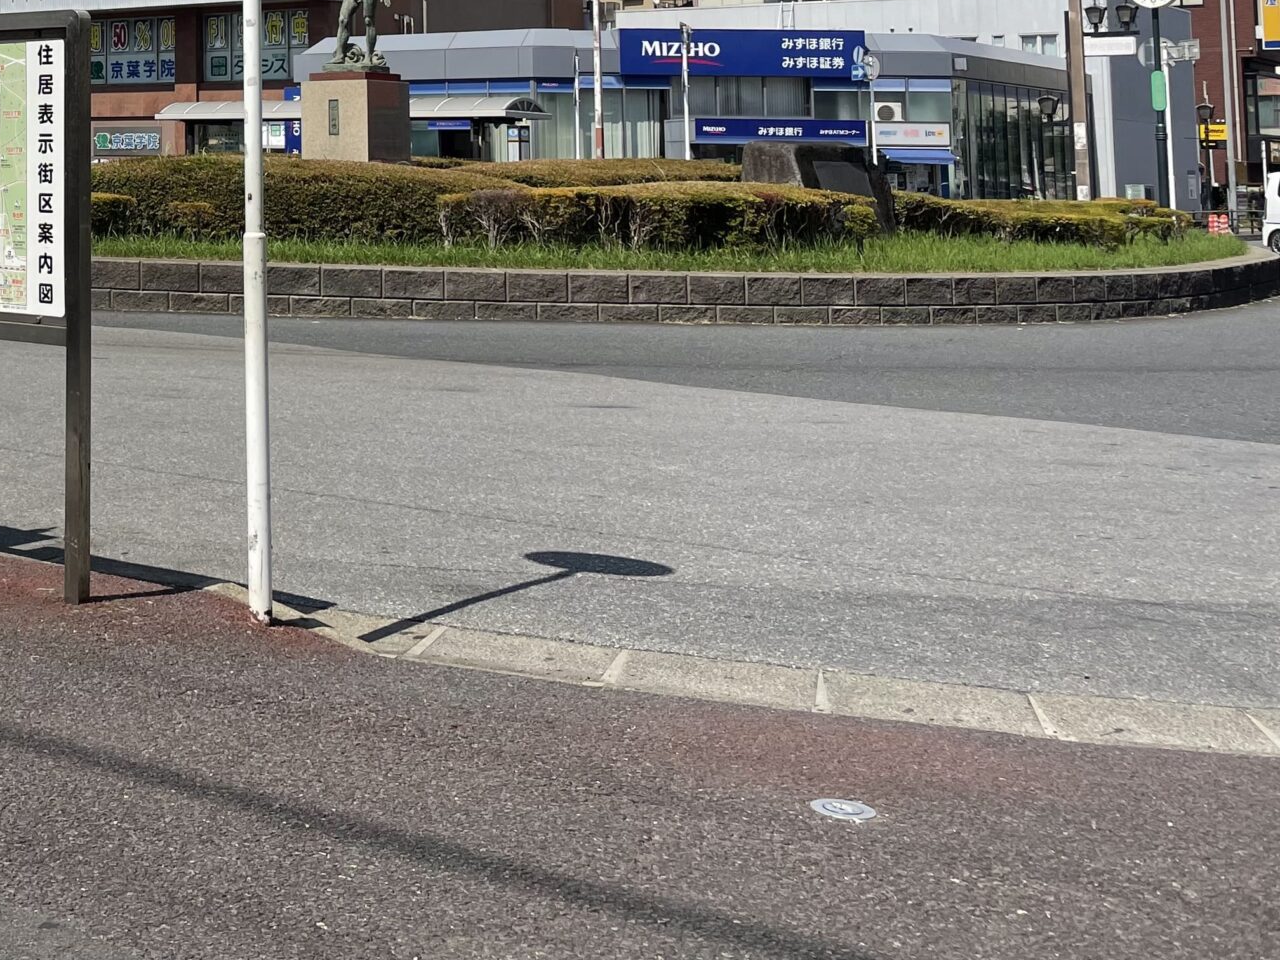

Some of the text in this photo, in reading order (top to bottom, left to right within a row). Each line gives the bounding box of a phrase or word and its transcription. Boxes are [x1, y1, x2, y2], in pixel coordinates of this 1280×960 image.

[781, 37, 844, 50] みずほ銀行
[111, 59, 175, 80] 京葉学院
[781, 56, 845, 70] みずほ証券
[758, 127, 803, 136] みずほ銀行
[111, 132, 160, 151] 京葉学院
[38, 44, 55, 305] 住居表示街区案内図
